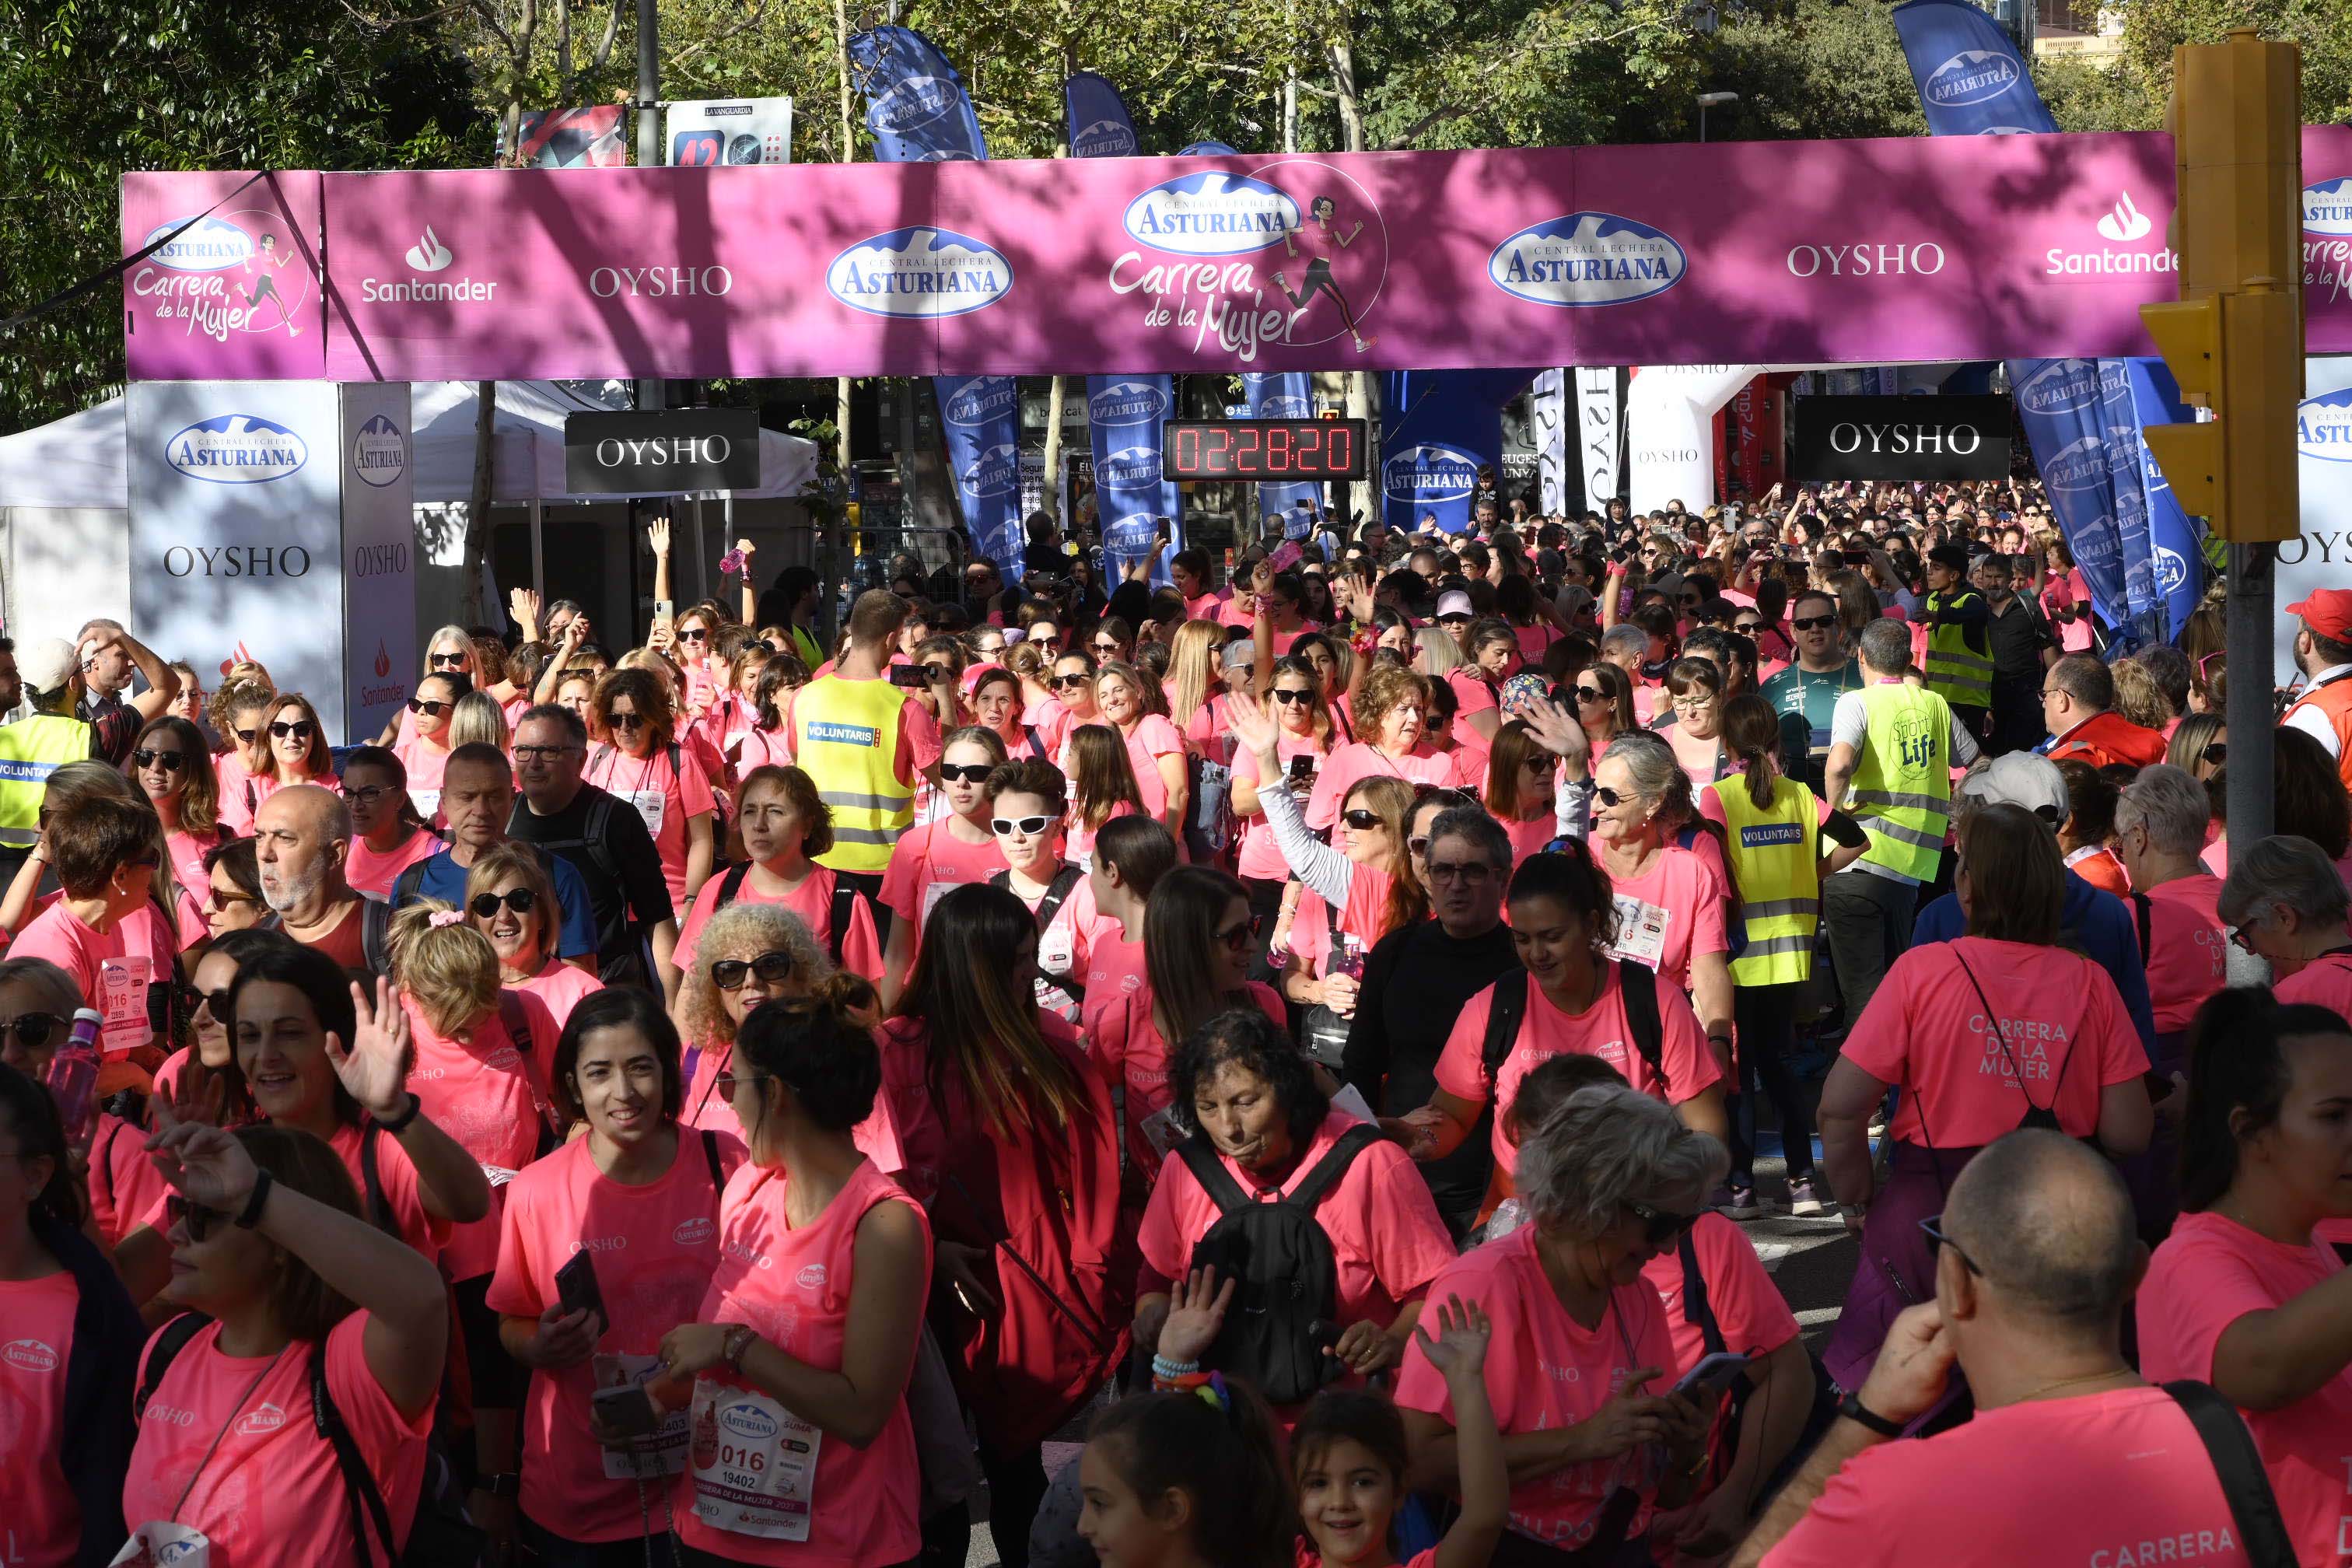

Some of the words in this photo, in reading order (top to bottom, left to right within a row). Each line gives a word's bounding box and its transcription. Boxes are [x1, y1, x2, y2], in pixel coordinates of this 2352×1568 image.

[713, 107, 752, 115] VANGUARDIA
[1139, 203, 1286, 234] ASTURIANA
[151, 236, 245, 257] ASTURIANA
[1535, 245, 1596, 256] CENTRAL
[1601, 243, 1664, 254] LECHERA
[1787, 242, 1944, 277] OYSHO
[870, 257, 929, 267] CENTRAL
[934, 257, 992, 267] LECHERA
[1108, 250, 1254, 294] Carrera
[1503, 248, 1671, 283] ASTURIANA
[134, 268, 224, 296] Carrera
[590, 265, 733, 297] OYSHO
[841, 259, 999, 295] ASTURIANA
[2319, 267, 2333, 285] la
[362, 277, 497, 303] Santander
[156, 298, 173, 318] de
[177, 298, 189, 318] la
[187, 295, 260, 342] Mujer
[1145, 297, 1171, 327] de
[1178, 296, 1197, 327] la
[1193, 289, 1308, 362] Mujer
[597, 434, 731, 467] OYSHO
[1177, 429, 1350, 471] 02:28:20
[1830, 422, 1980, 455] OYSHO
[177, 439, 298, 467] ASTURIANA
[358, 441, 403, 469] ASTURIANA
[1639, 449, 1698, 464] OYSHO
[1386, 469, 1474, 491] ASTURIANA
[164, 546, 311, 578] OYSHO
[355, 542, 407, 578] OYSHO
[361, 681, 405, 708] Santander
[809, 726, 872, 742] VOLUNTARIS
[1893, 716, 1930, 742] Sport
[1900, 733, 1935, 768] Life
[1742, 828, 1801, 842] VOLUNTARIS
[933, 866, 955, 876] SHO
[1969, 1014, 2068, 1042] CARRERA
[1986, 1036, 2014, 1057] DE
[2020, 1039, 2048, 1061] LA
[1979, 1055, 2050, 1080] MUJER
[569, 1235, 626, 1255] OYSHO
[724, 1412, 773, 1436] ASTURIANA
[783, 1420, 811, 1433] SUMA
[721, 1444, 765, 1472] 016
[722, 1471, 755, 1489] 19402
[733, 1493, 742, 1501] LA
[744, 1495, 773, 1507] MUJER
[751, 1515, 798, 1530] Santander
[2090, 1527, 2235, 1568] CARRERA
